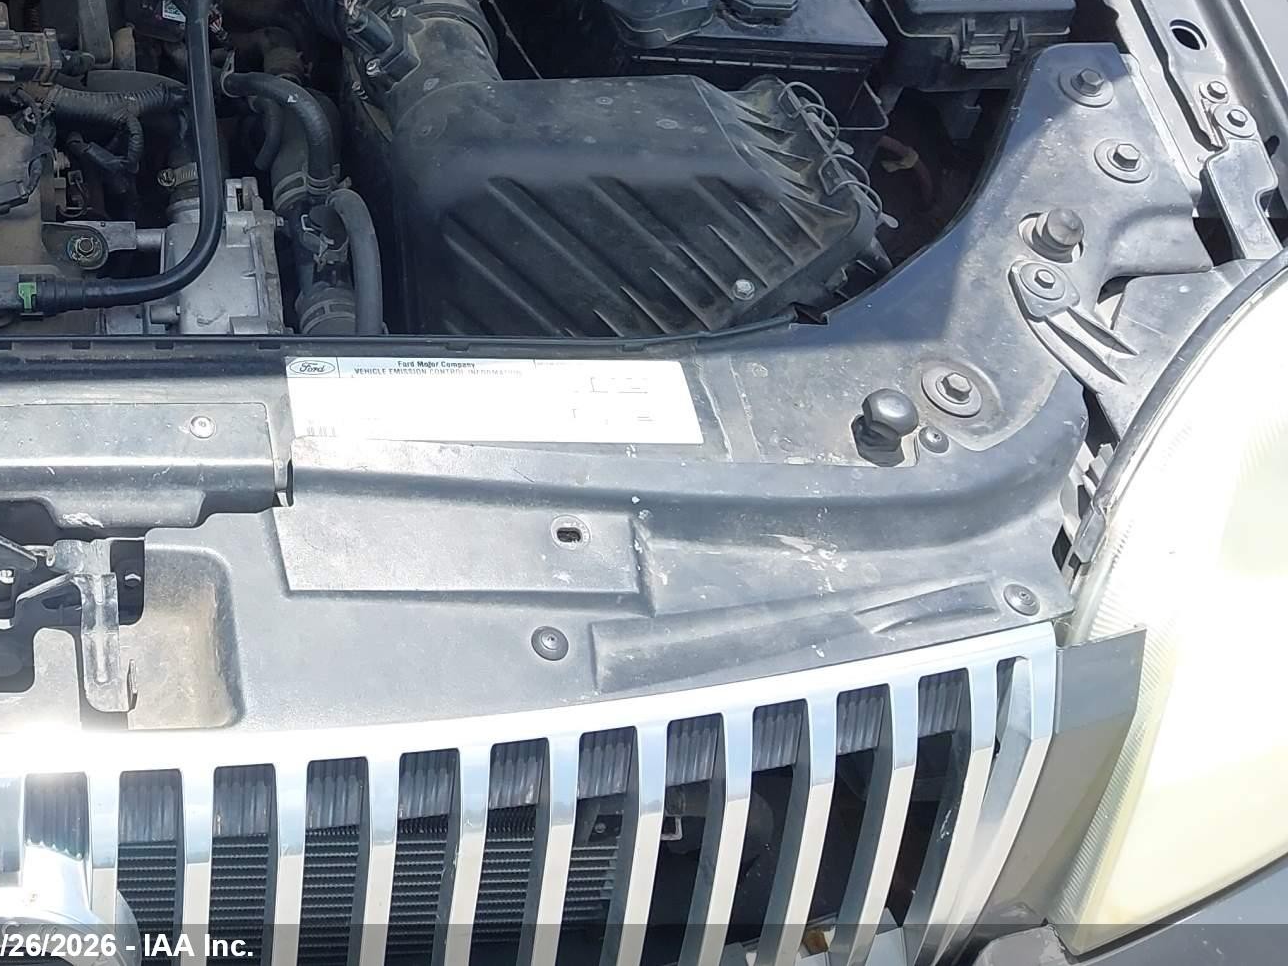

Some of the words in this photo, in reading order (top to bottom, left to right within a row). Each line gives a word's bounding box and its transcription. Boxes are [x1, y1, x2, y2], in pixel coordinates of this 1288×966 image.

[299, 361, 326, 373] Ford
[397, 360, 415, 368] Ford
[416, 360, 439, 368] Motor
[440, 361, 476, 369] Company
